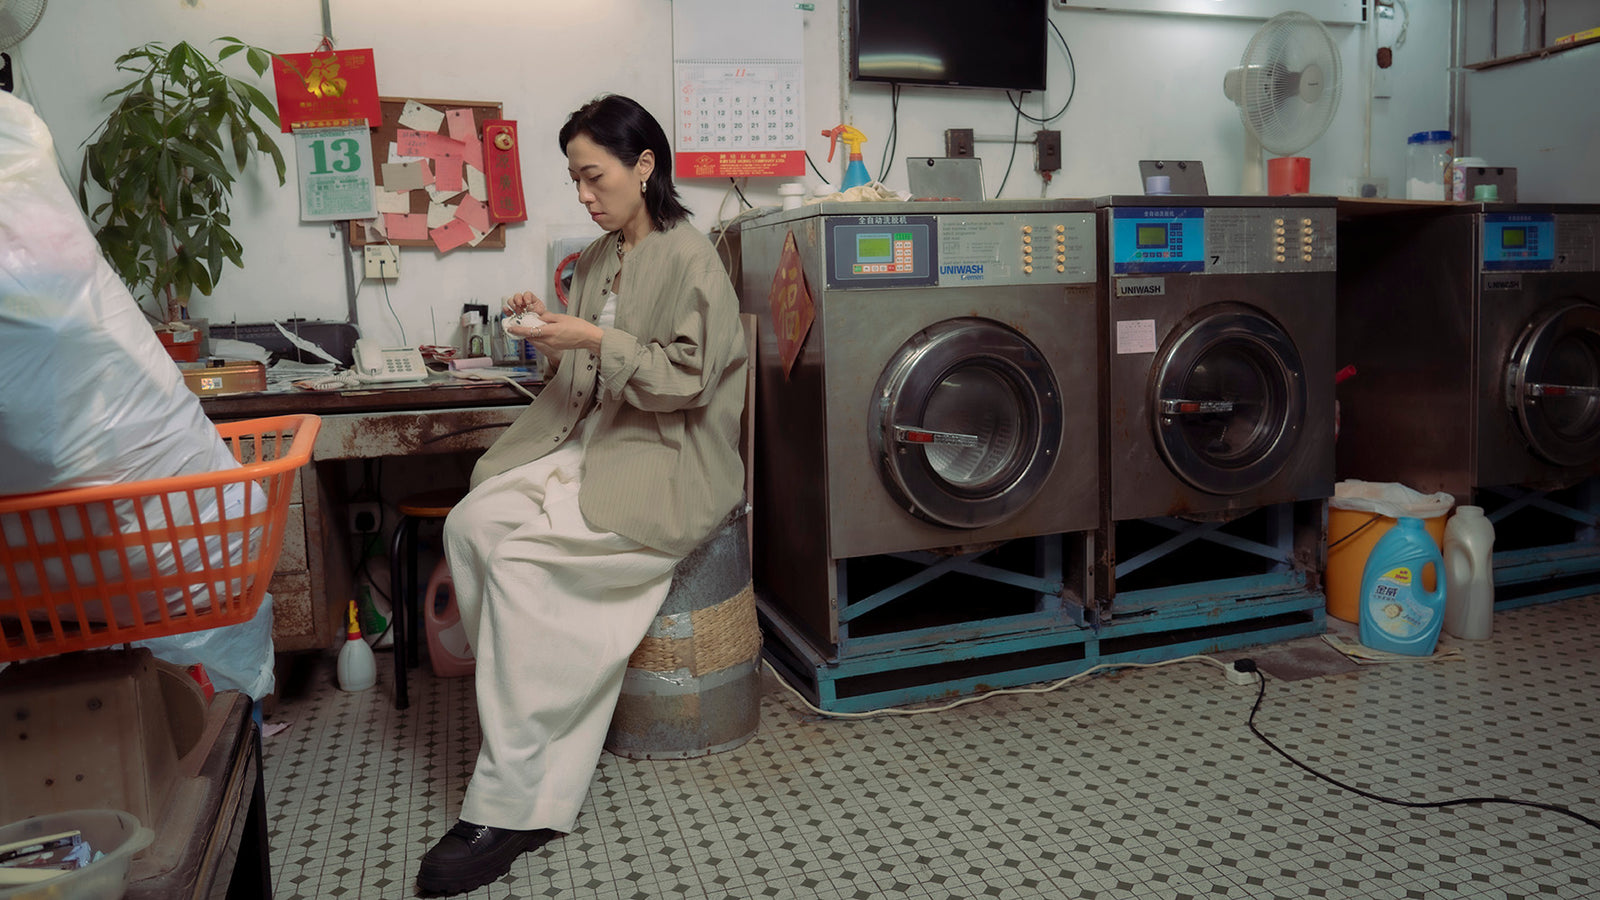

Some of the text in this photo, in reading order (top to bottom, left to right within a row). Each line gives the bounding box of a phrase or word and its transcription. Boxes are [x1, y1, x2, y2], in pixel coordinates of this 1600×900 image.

[304, 56, 347, 98] 福
[736, 68, 746, 77] 11
[309, 138, 362, 175] 13
[1210, 256, 1220, 265] 7
[940, 265, 984, 274] UNIWASH
[1121, 285, 1161, 295] UNIWASH
